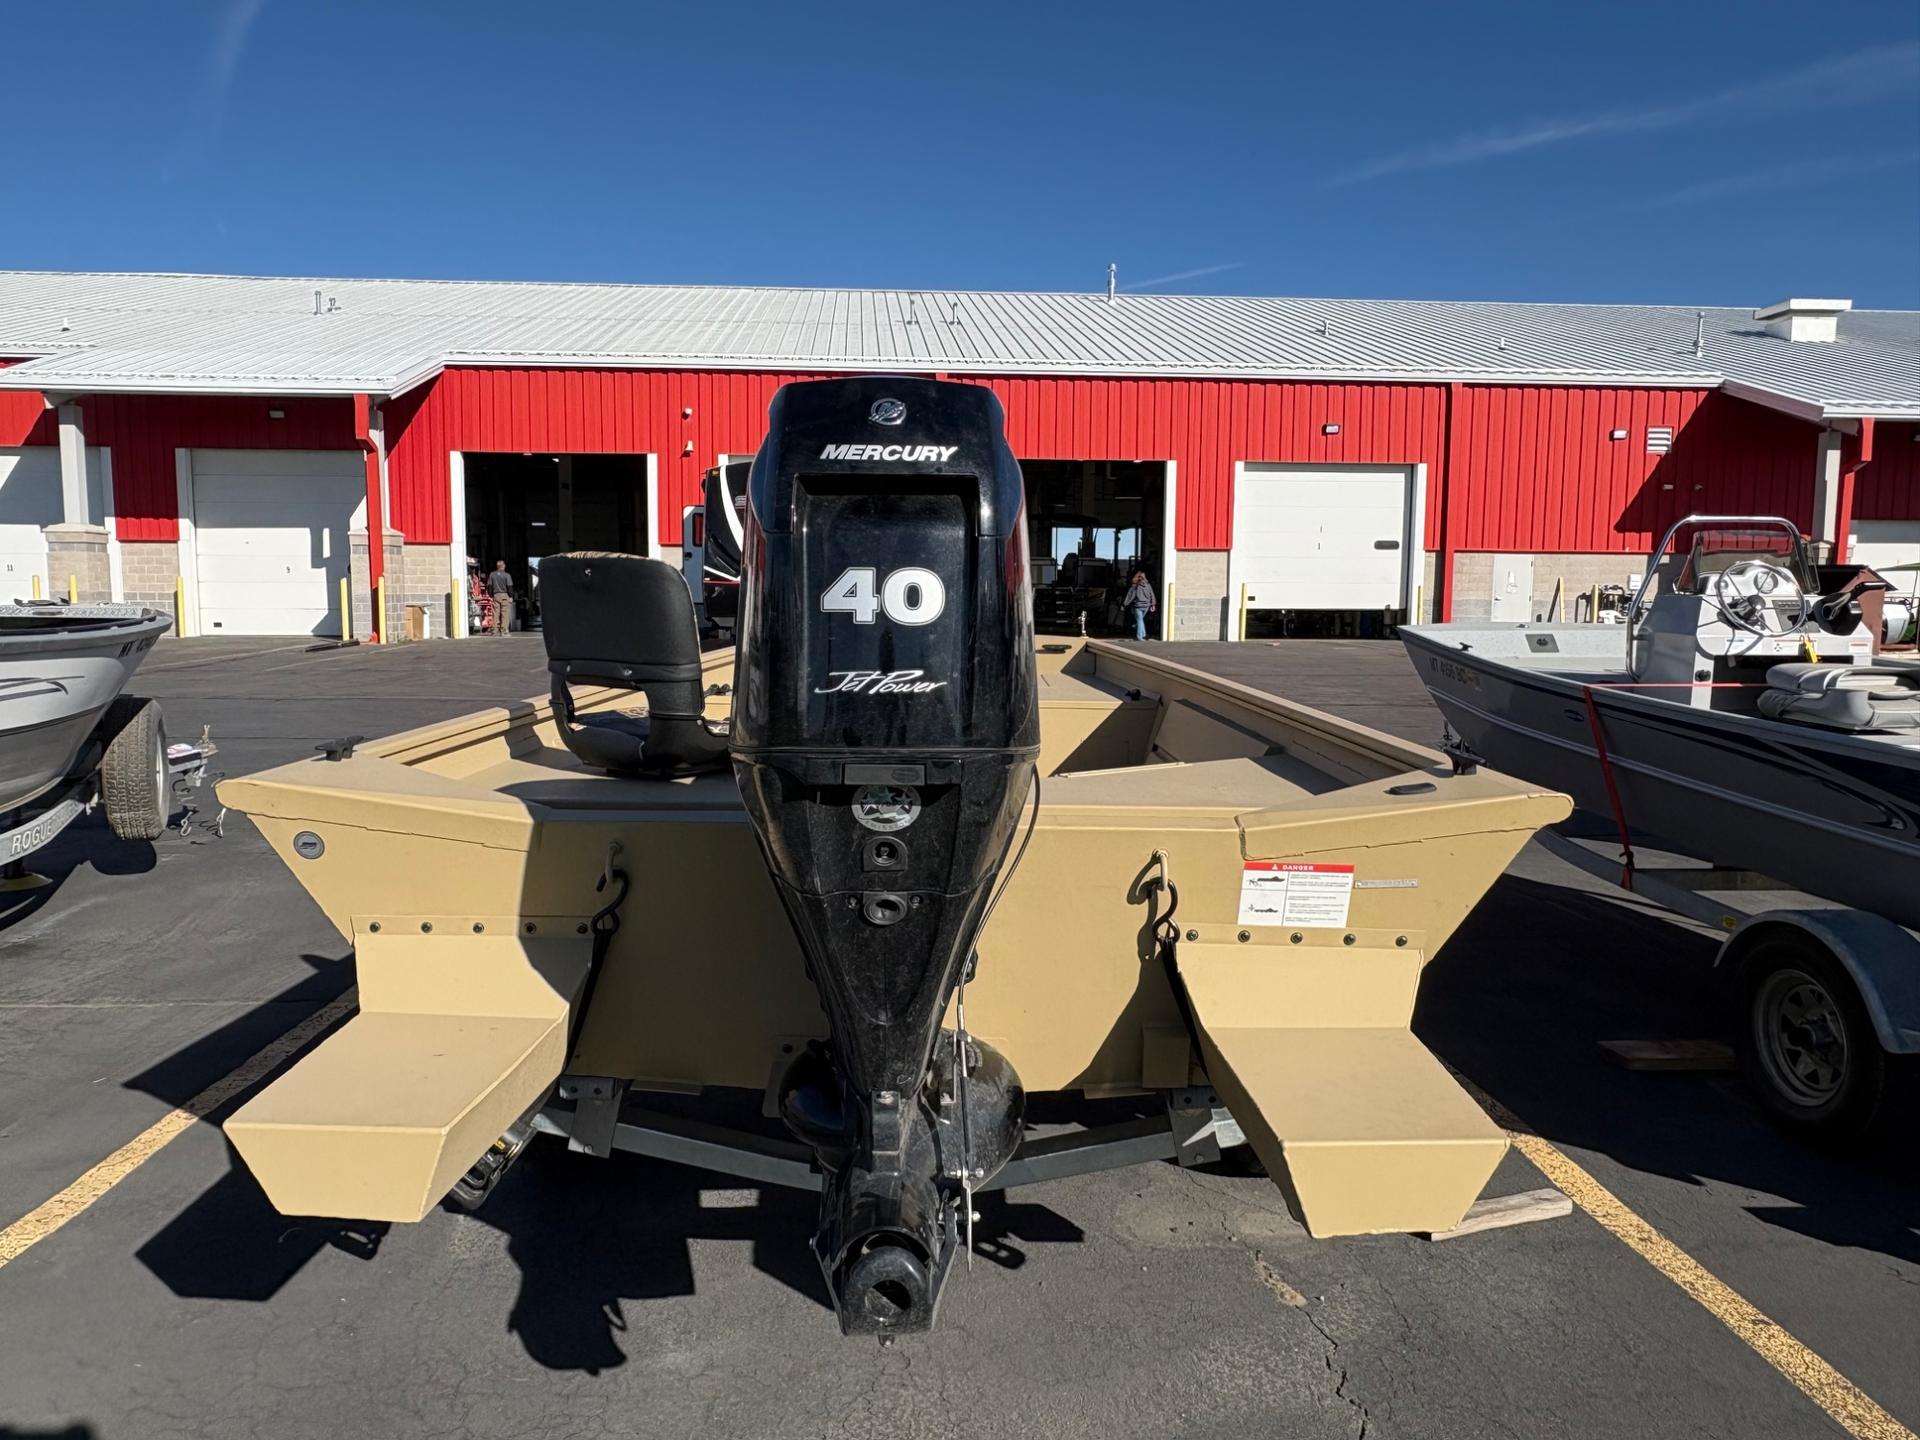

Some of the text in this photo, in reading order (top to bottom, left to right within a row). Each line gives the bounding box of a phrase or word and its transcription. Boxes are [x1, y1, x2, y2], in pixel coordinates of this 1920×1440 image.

[820, 444, 958, 462] MERCURY
[821, 567, 946, 626] 40
[10, 820, 52, 856] ROGUE
